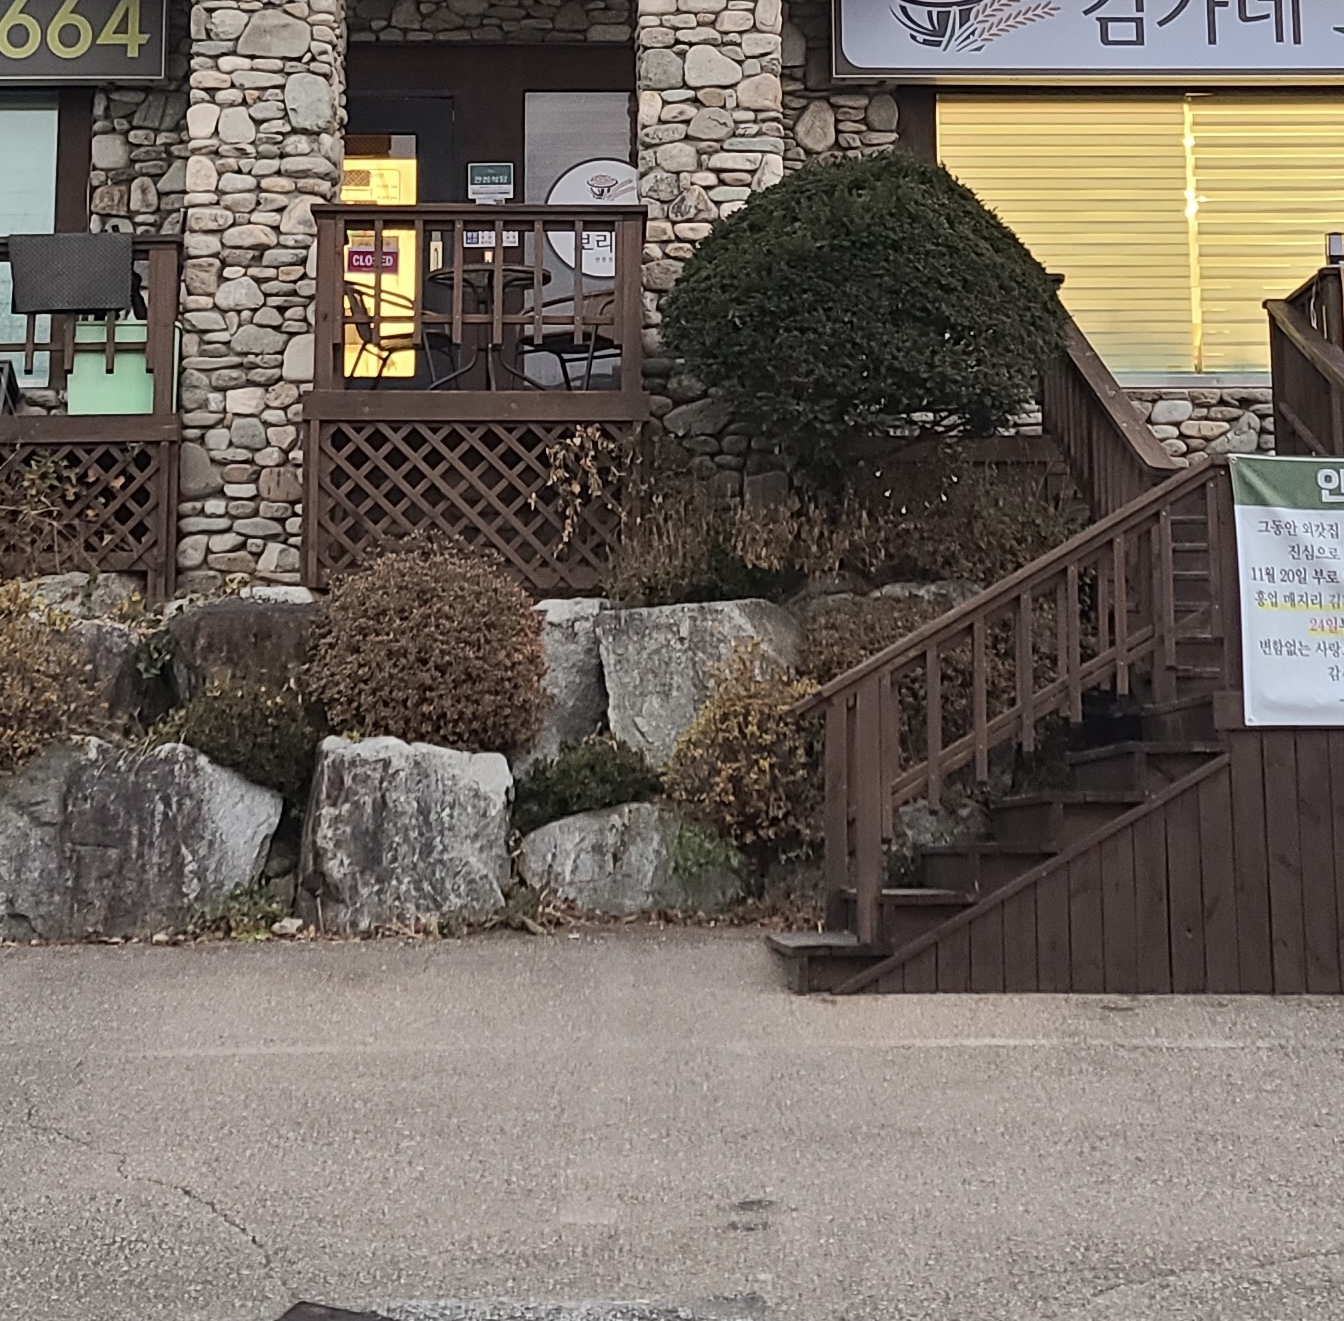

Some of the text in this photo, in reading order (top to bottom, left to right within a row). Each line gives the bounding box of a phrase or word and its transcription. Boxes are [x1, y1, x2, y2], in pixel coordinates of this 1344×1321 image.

[352, 254, 394, 267] CLOED
[1257, 519, 1298, 537] 그동안
[1302, 522, 1339, 540] 외갓집
[1288, 544, 1341, 561] 진심으로
[1251, 566, 1276, 584] 11월
[1279, 567, 1308, 585] 20일
[1312, 568, 1339, 585] 부로
[1283, 591, 1323, 609] 매지리
[1259, 638, 1311, 657] 변함없는
